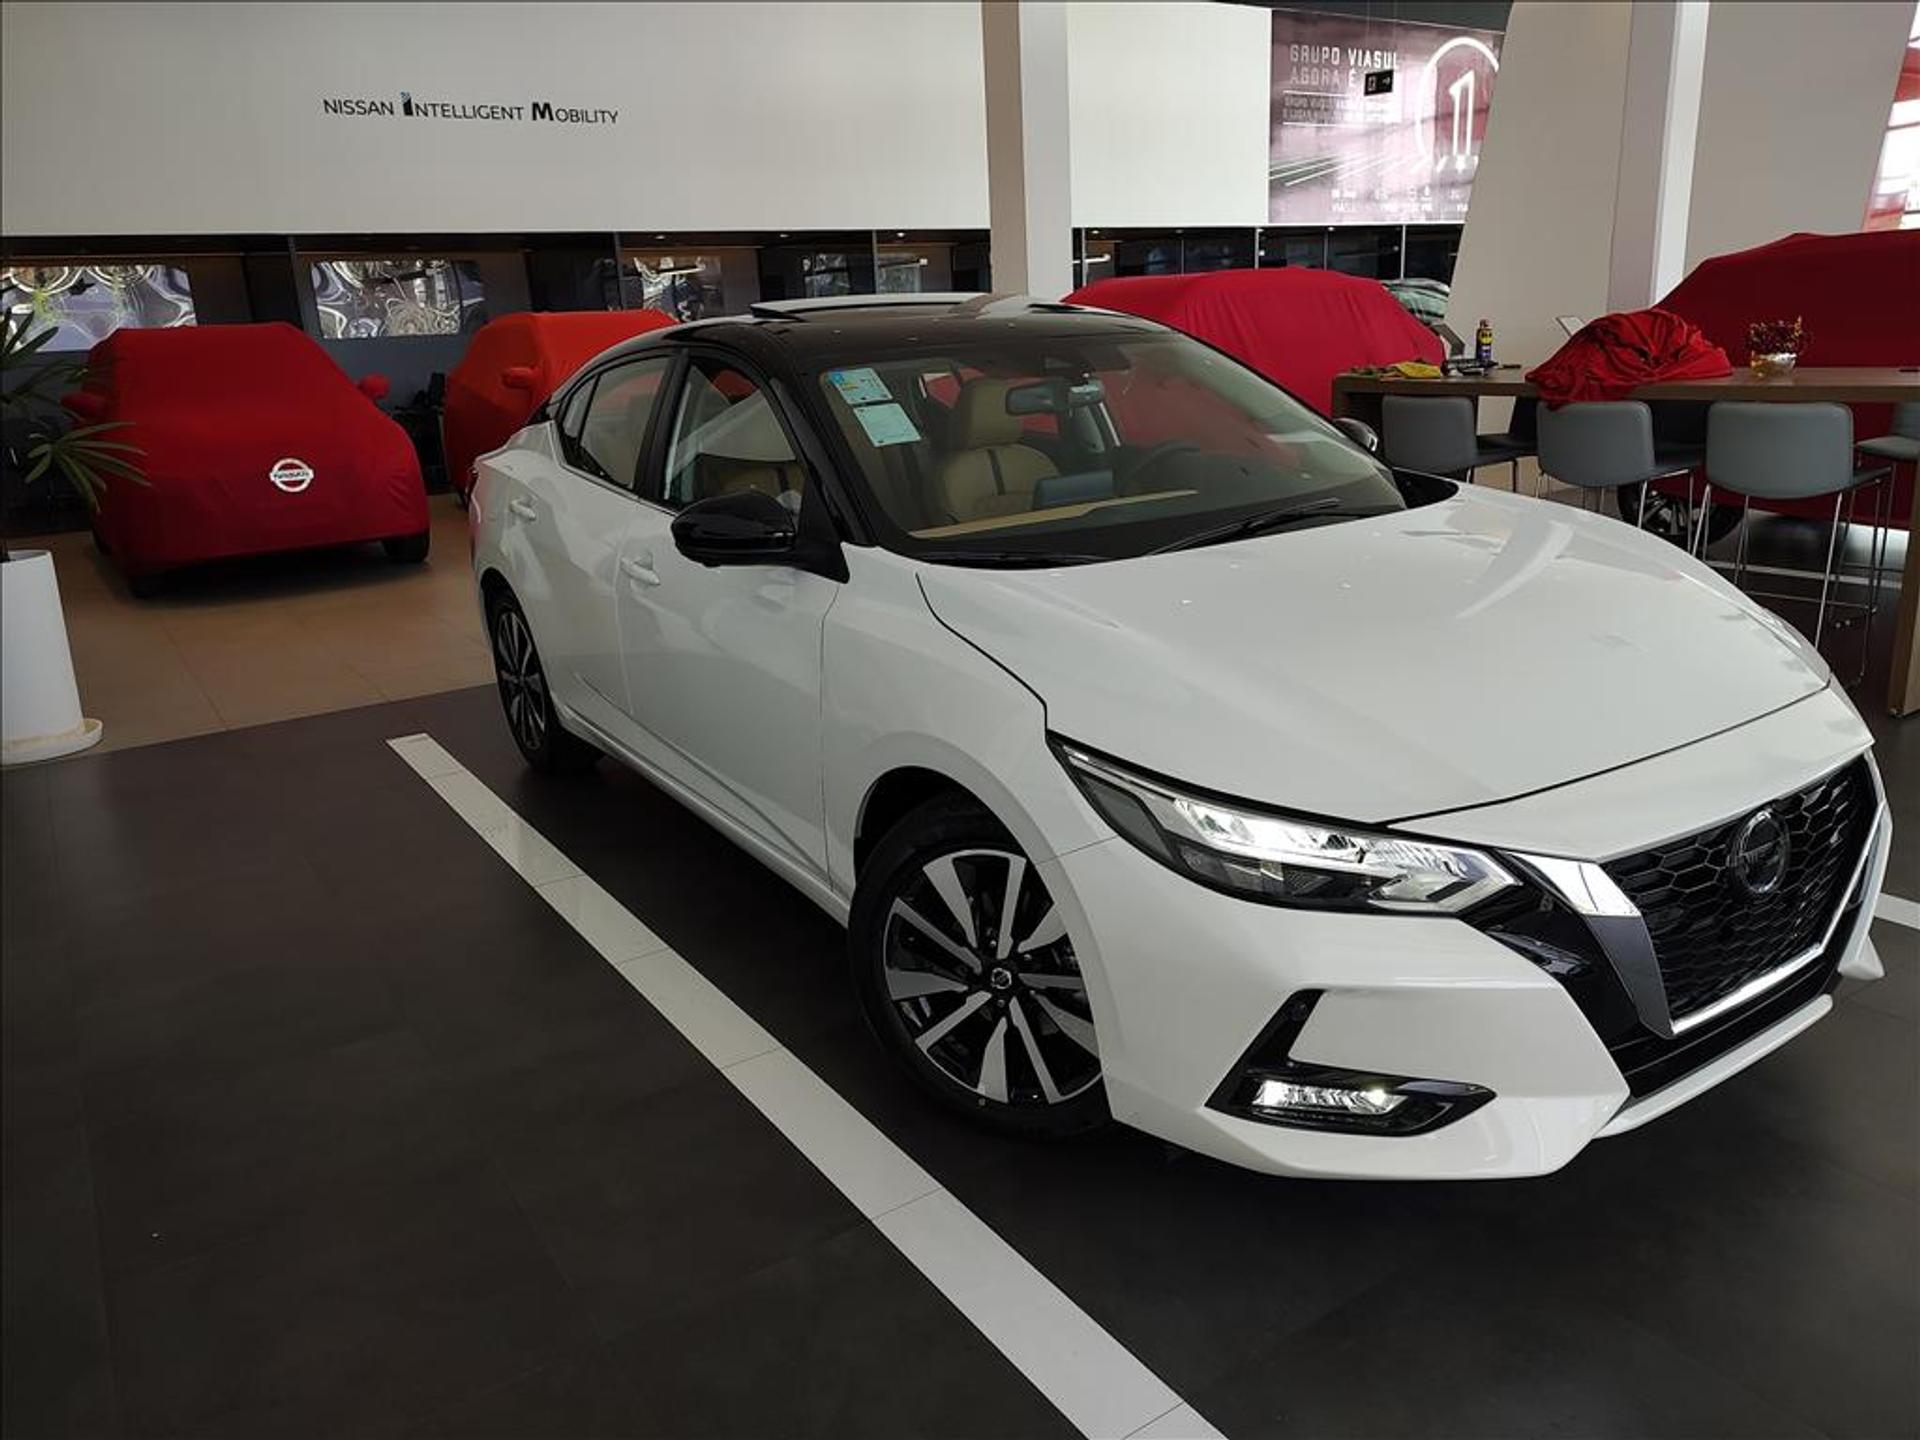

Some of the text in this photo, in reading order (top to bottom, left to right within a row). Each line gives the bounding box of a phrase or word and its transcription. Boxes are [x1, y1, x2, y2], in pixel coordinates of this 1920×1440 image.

[1290, 44, 1399, 69] GRUPO VIASUL
[1290, 65, 1357, 87] AGORA É
[323, 91, 618, 124] NISSAN INTELLIGENT MOBILITY
